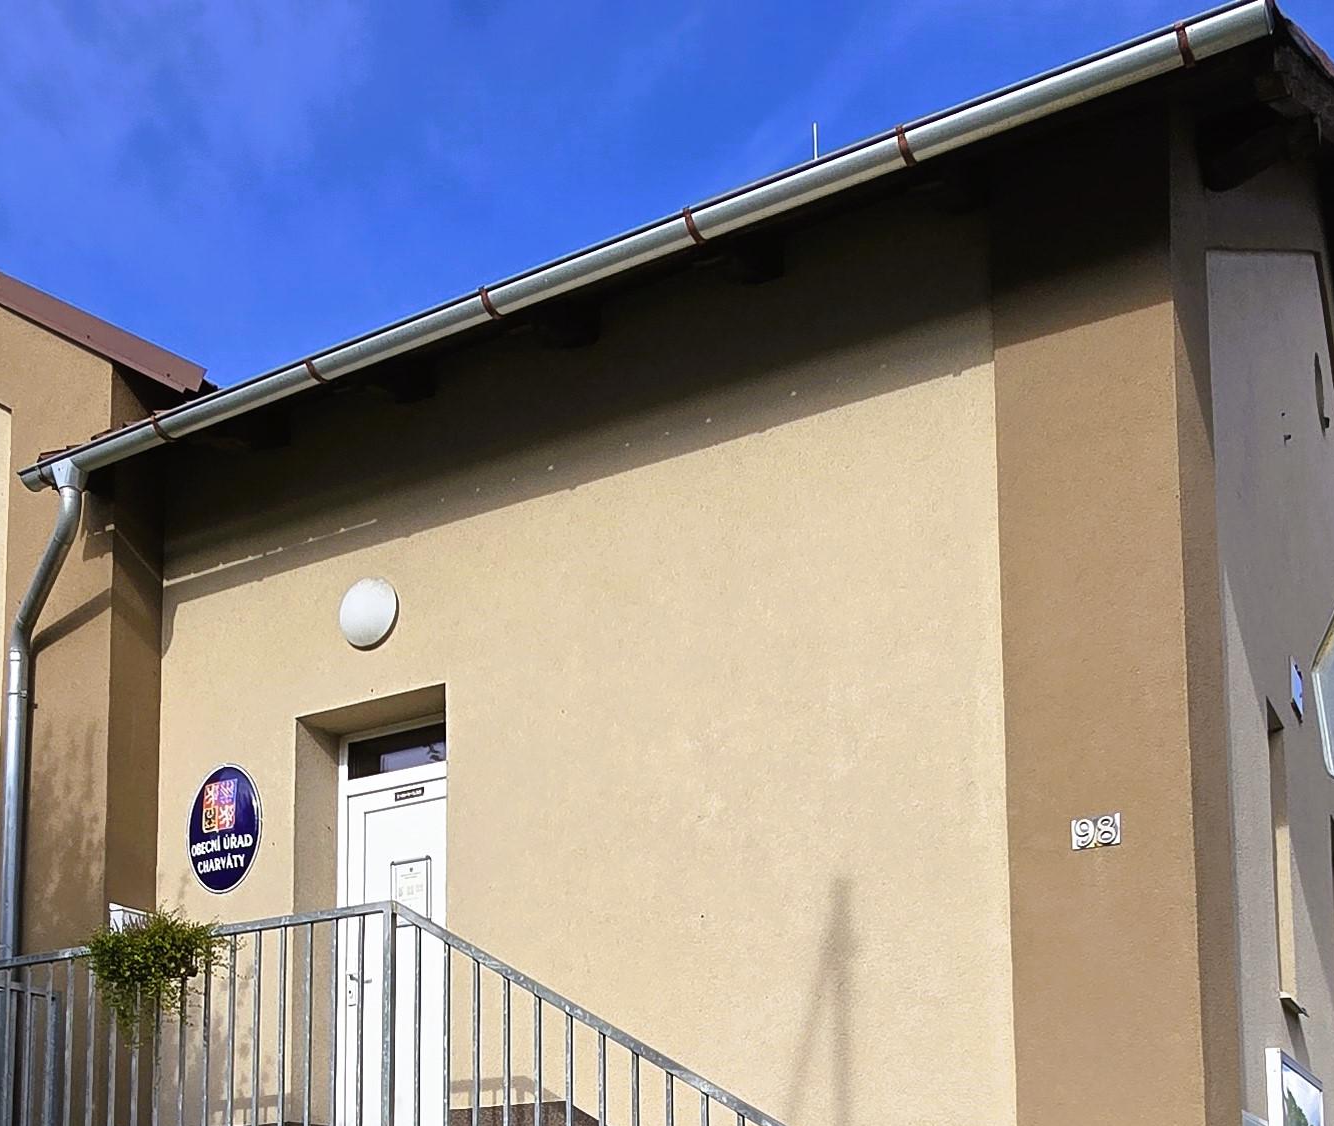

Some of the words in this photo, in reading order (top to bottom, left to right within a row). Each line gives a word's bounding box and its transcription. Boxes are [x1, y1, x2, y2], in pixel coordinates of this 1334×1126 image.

[1074, 815, 1118, 848] 98
[191, 835, 221, 857] OBECNÍ
[223, 833, 253, 849] ÚŘAD
[197, 852, 245, 874] CHARVÁTY
